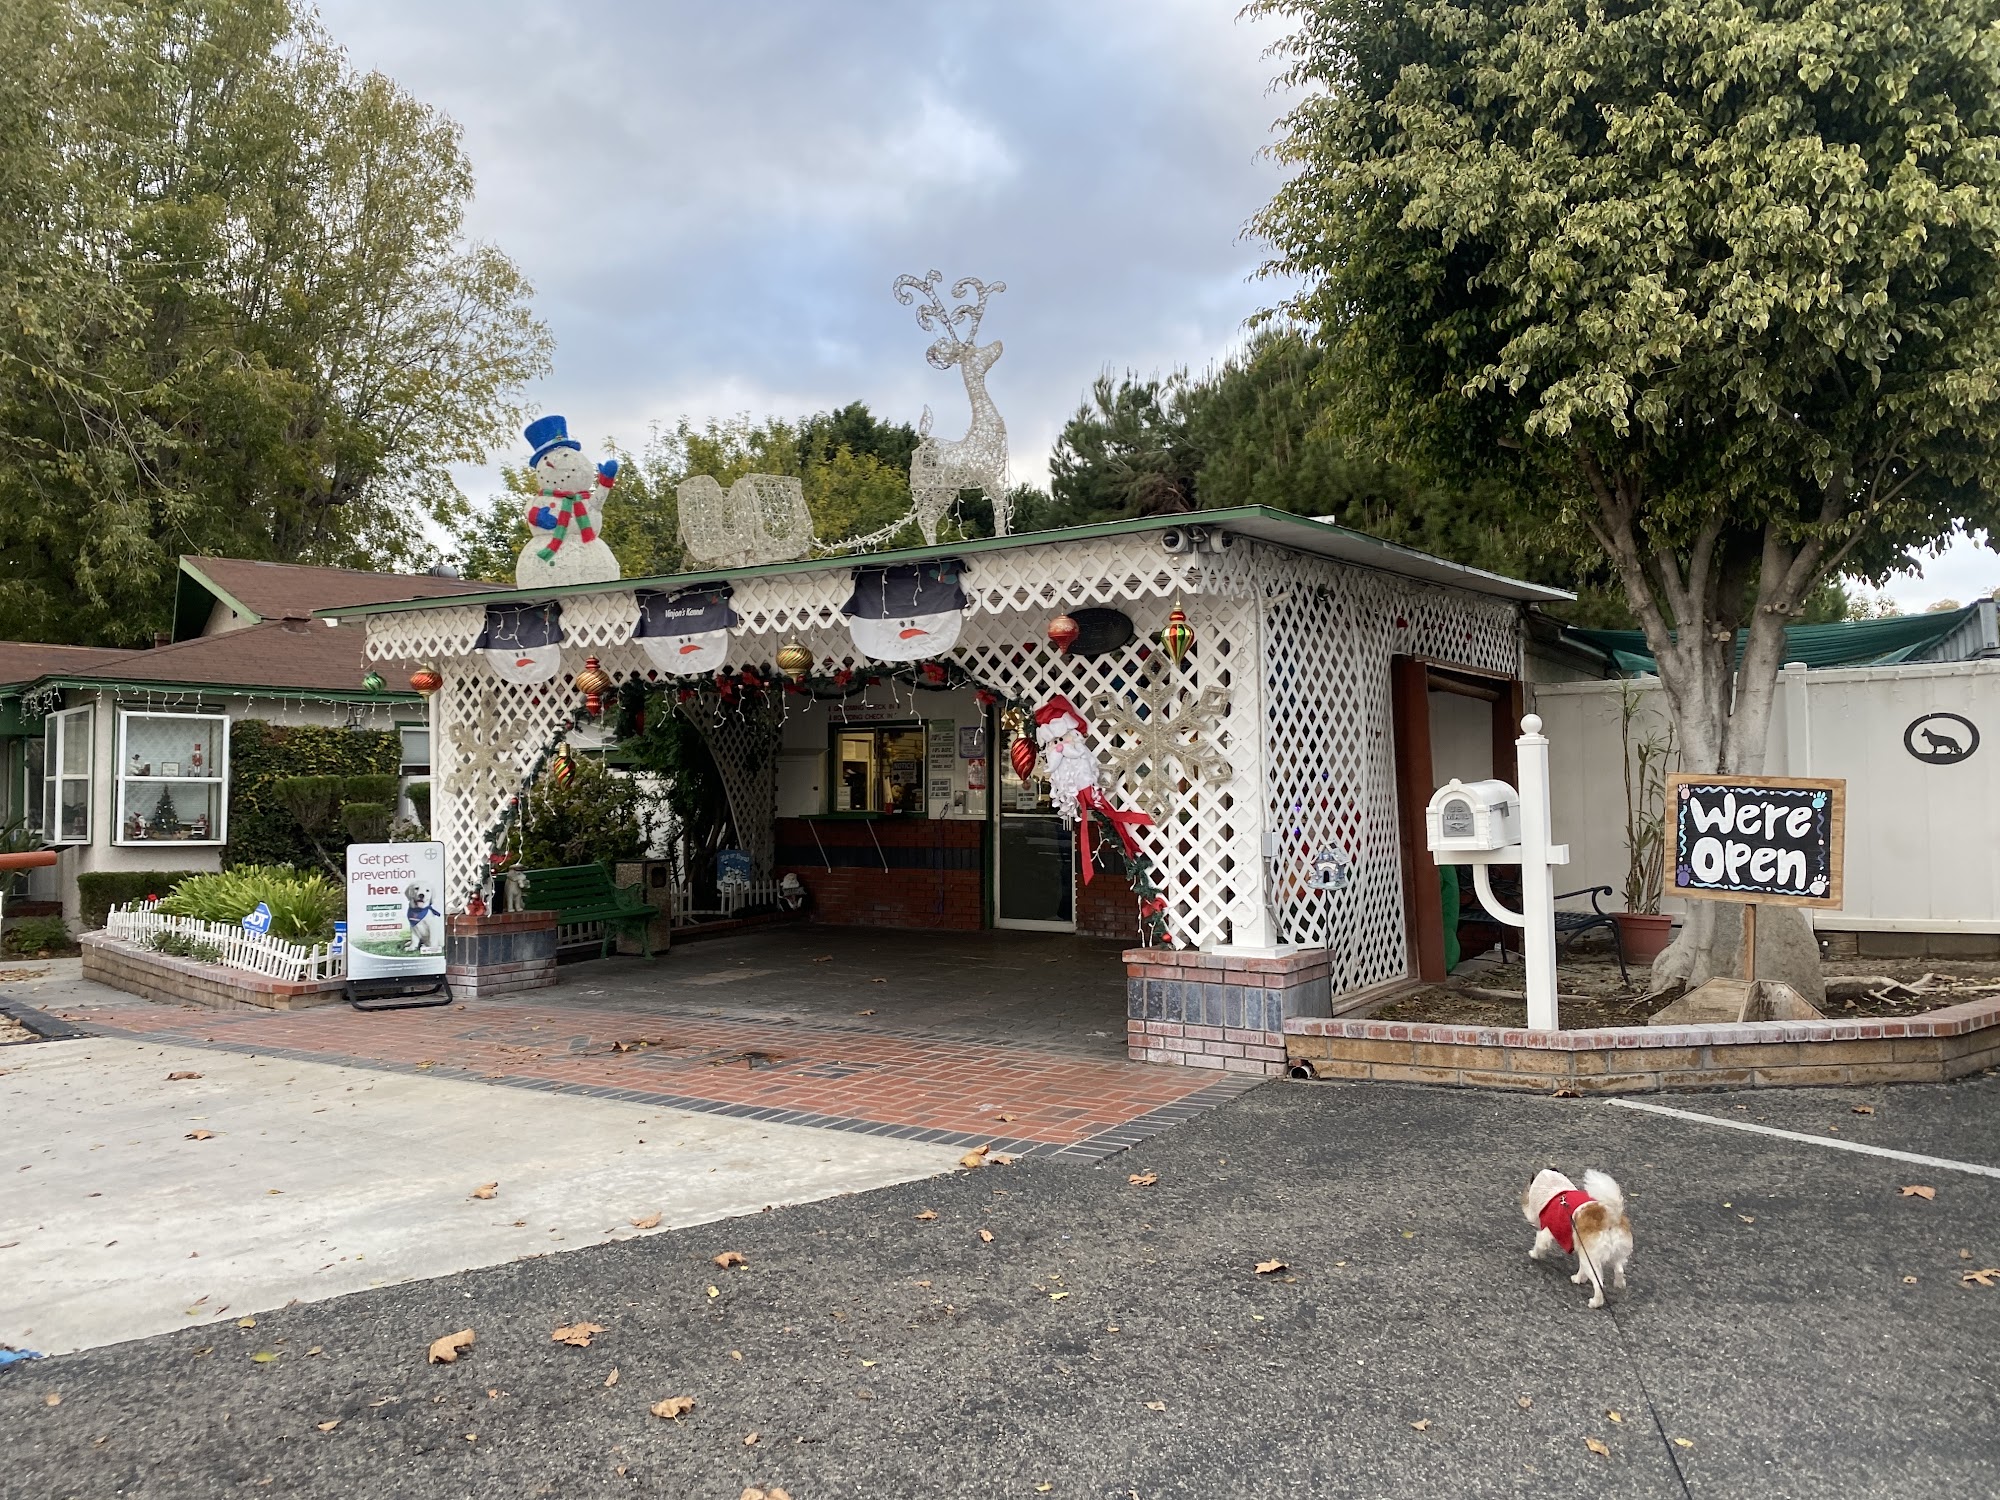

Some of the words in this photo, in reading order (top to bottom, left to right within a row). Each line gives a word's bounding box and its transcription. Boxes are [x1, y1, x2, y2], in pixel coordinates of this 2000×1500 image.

[665, 608, 685, 620] Vinjon's
[686, 607, 705, 617] Kennel
[893, 762, 914, 770] NOTICE
[1689, 792, 1813, 841] We're
[358, 853, 380, 865] Get
[383, 853, 409, 867] pest
[351, 868, 416, 883] prevention
[367, 884, 401, 896] here.
[245, 911, 269, 928] ADT
